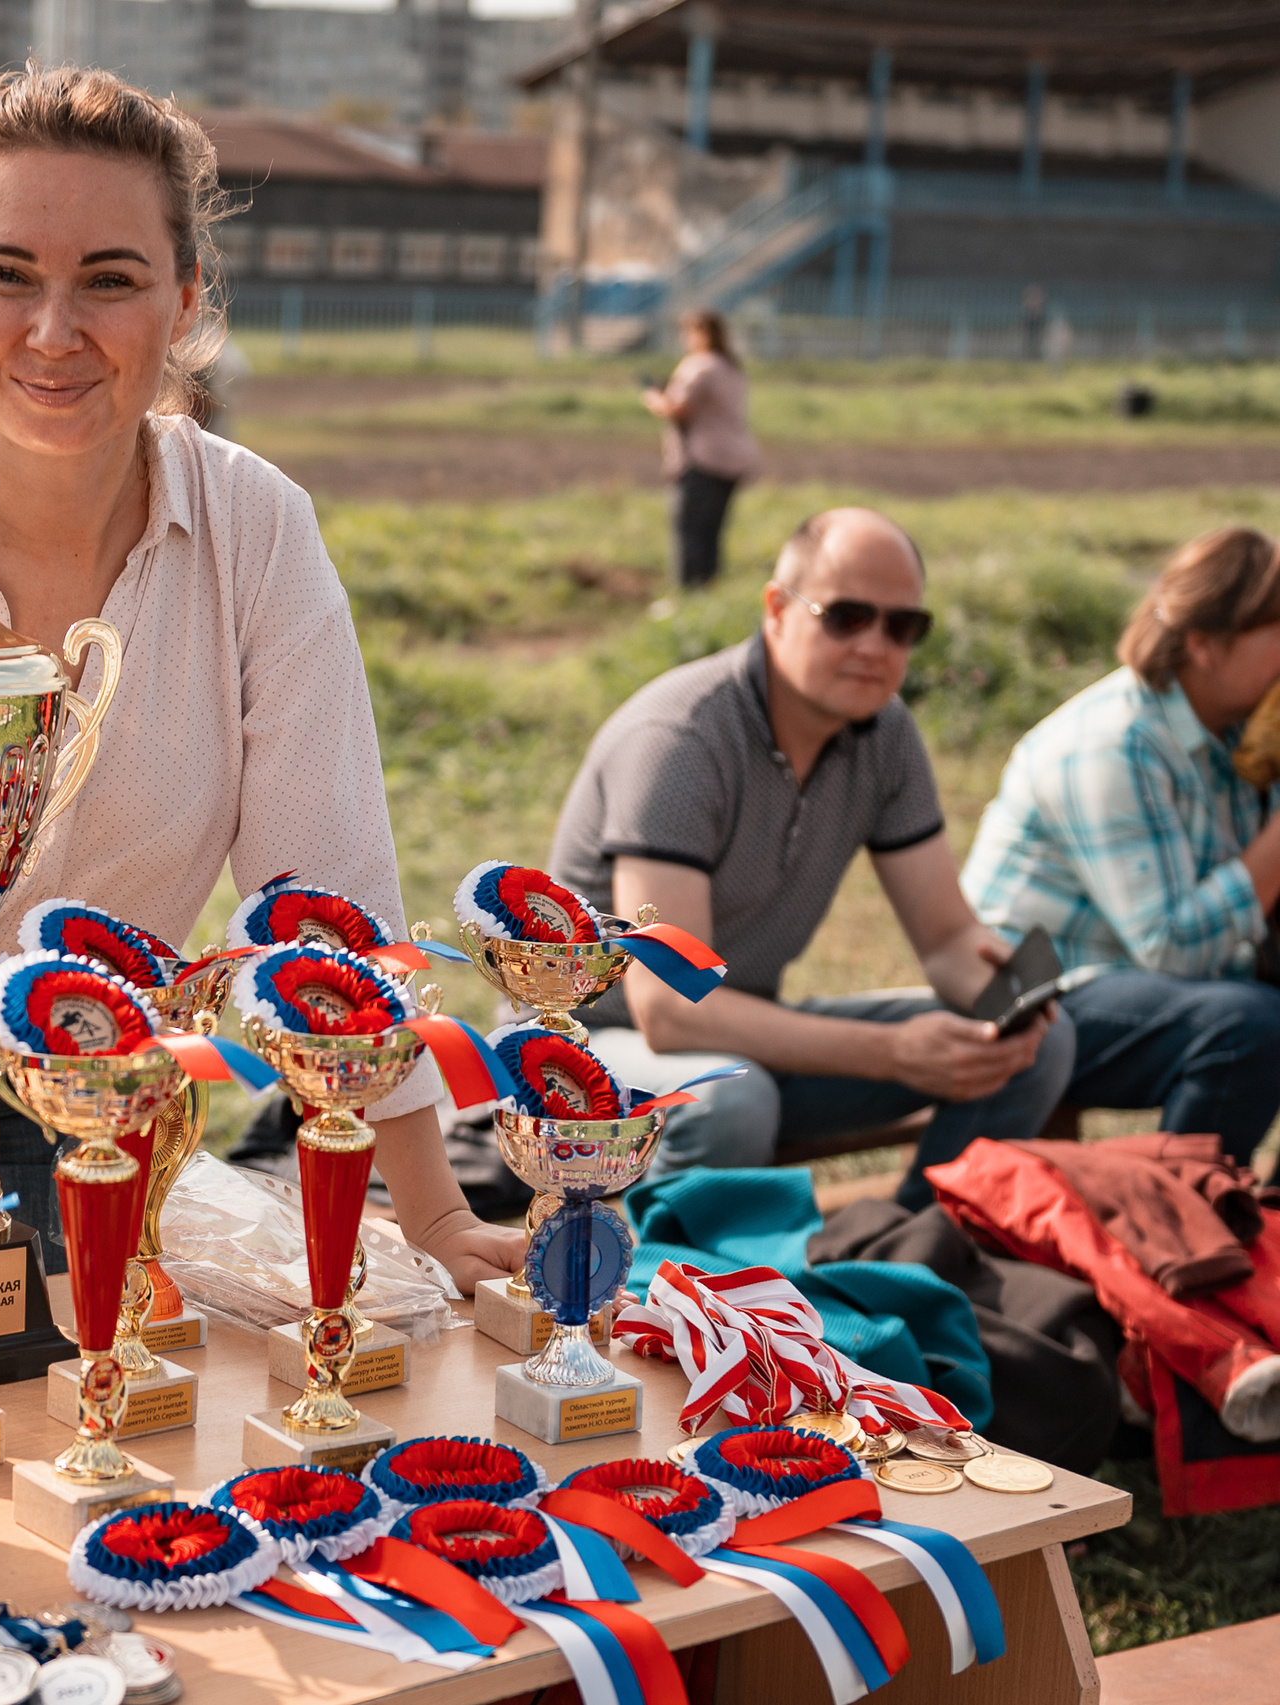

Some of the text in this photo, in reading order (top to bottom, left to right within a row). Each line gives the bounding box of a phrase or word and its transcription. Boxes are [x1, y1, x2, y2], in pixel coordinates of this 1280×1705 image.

[143, 1328, 167, 1336] Областной
[375, 1354, 396, 1363] турнир
[376, 1362, 399, 1371] выездке
[128, 1392, 184, 1408] Областной турнир
[570, 1397, 627, 1412] Областной турнир
[132, 1407, 156, 1416] конкуру
[164, 1400, 188, 1410] выездке
[574, 1412, 599, 1420] конкуру
[606, 1406, 631, 1415] выездке
[123, 1419, 145, 1427] памяти
[905, 1471, 932, 1479] 2021
